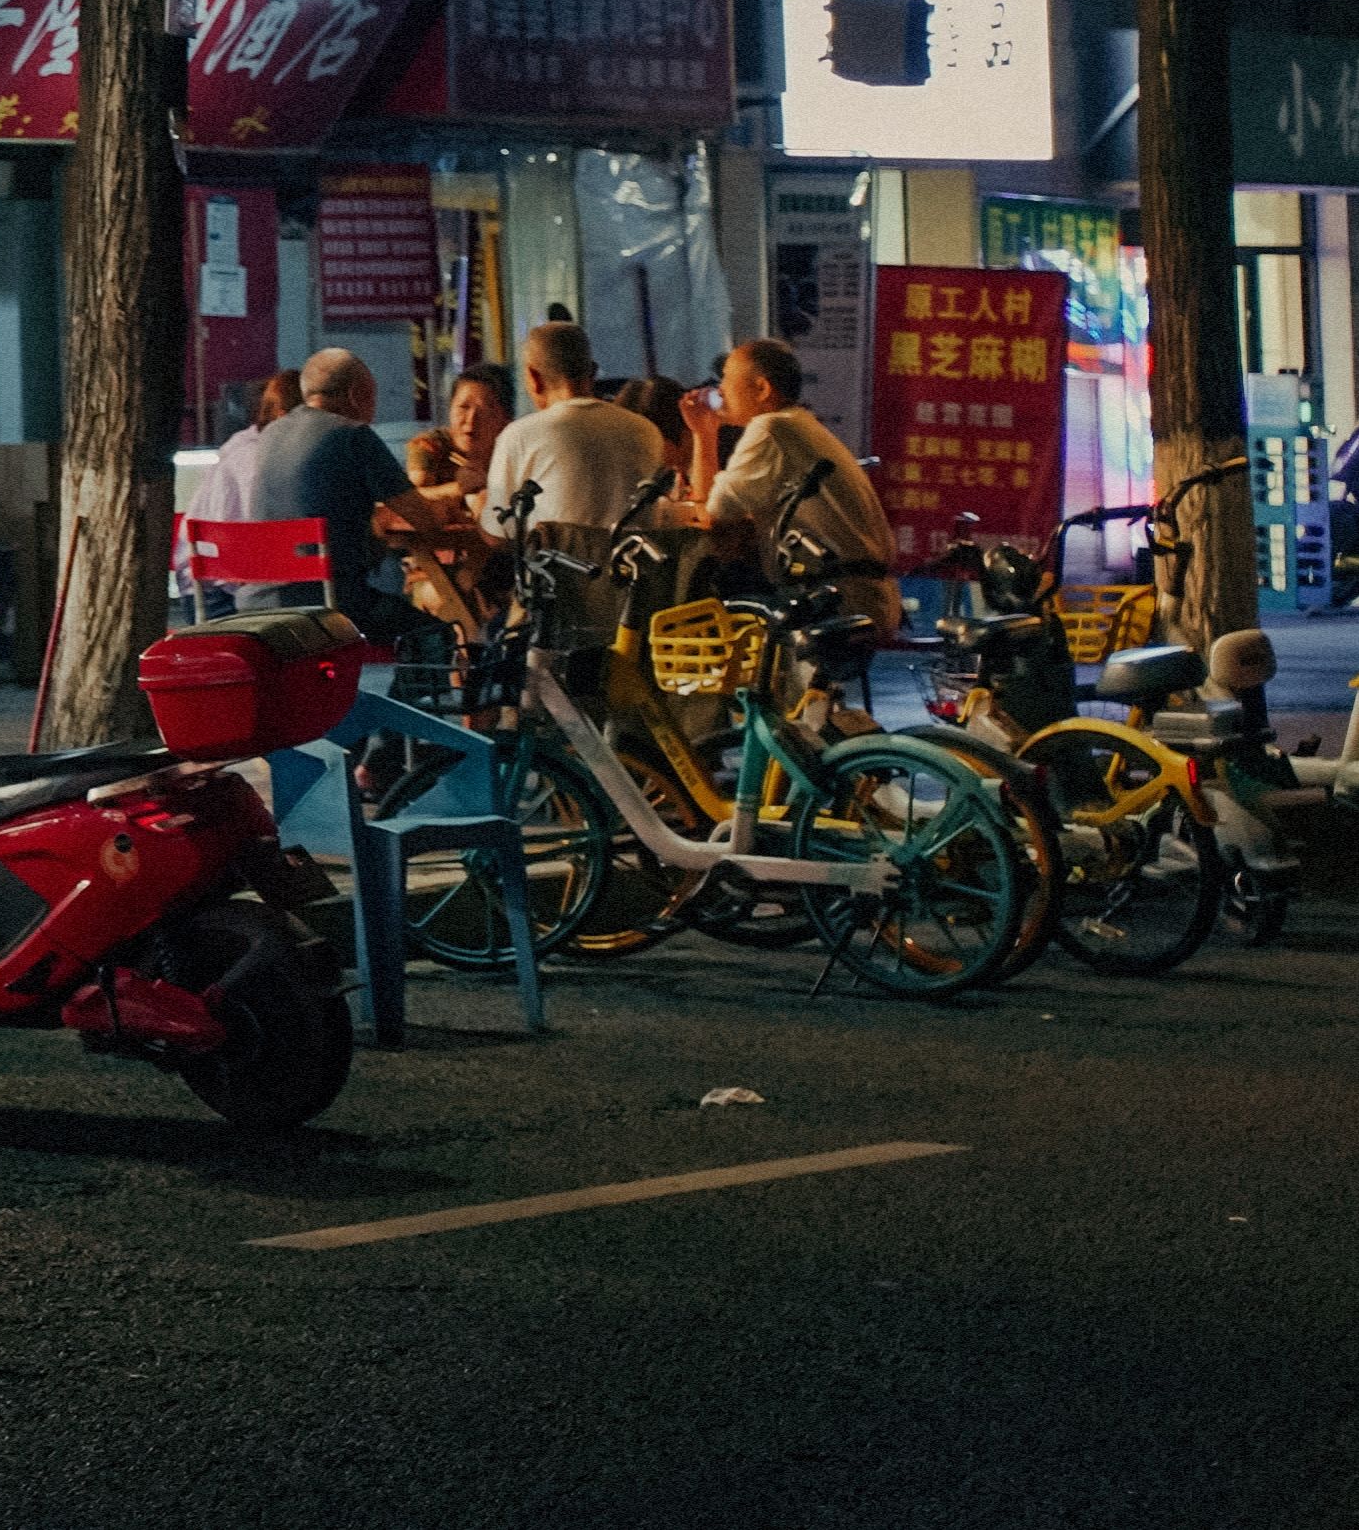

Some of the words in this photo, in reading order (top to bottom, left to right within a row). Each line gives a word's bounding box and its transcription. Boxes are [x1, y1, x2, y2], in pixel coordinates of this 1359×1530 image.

[905, 283, 1033, 324] 原工人村
[888, 331, 1048, 382] 黑芝麻糊
